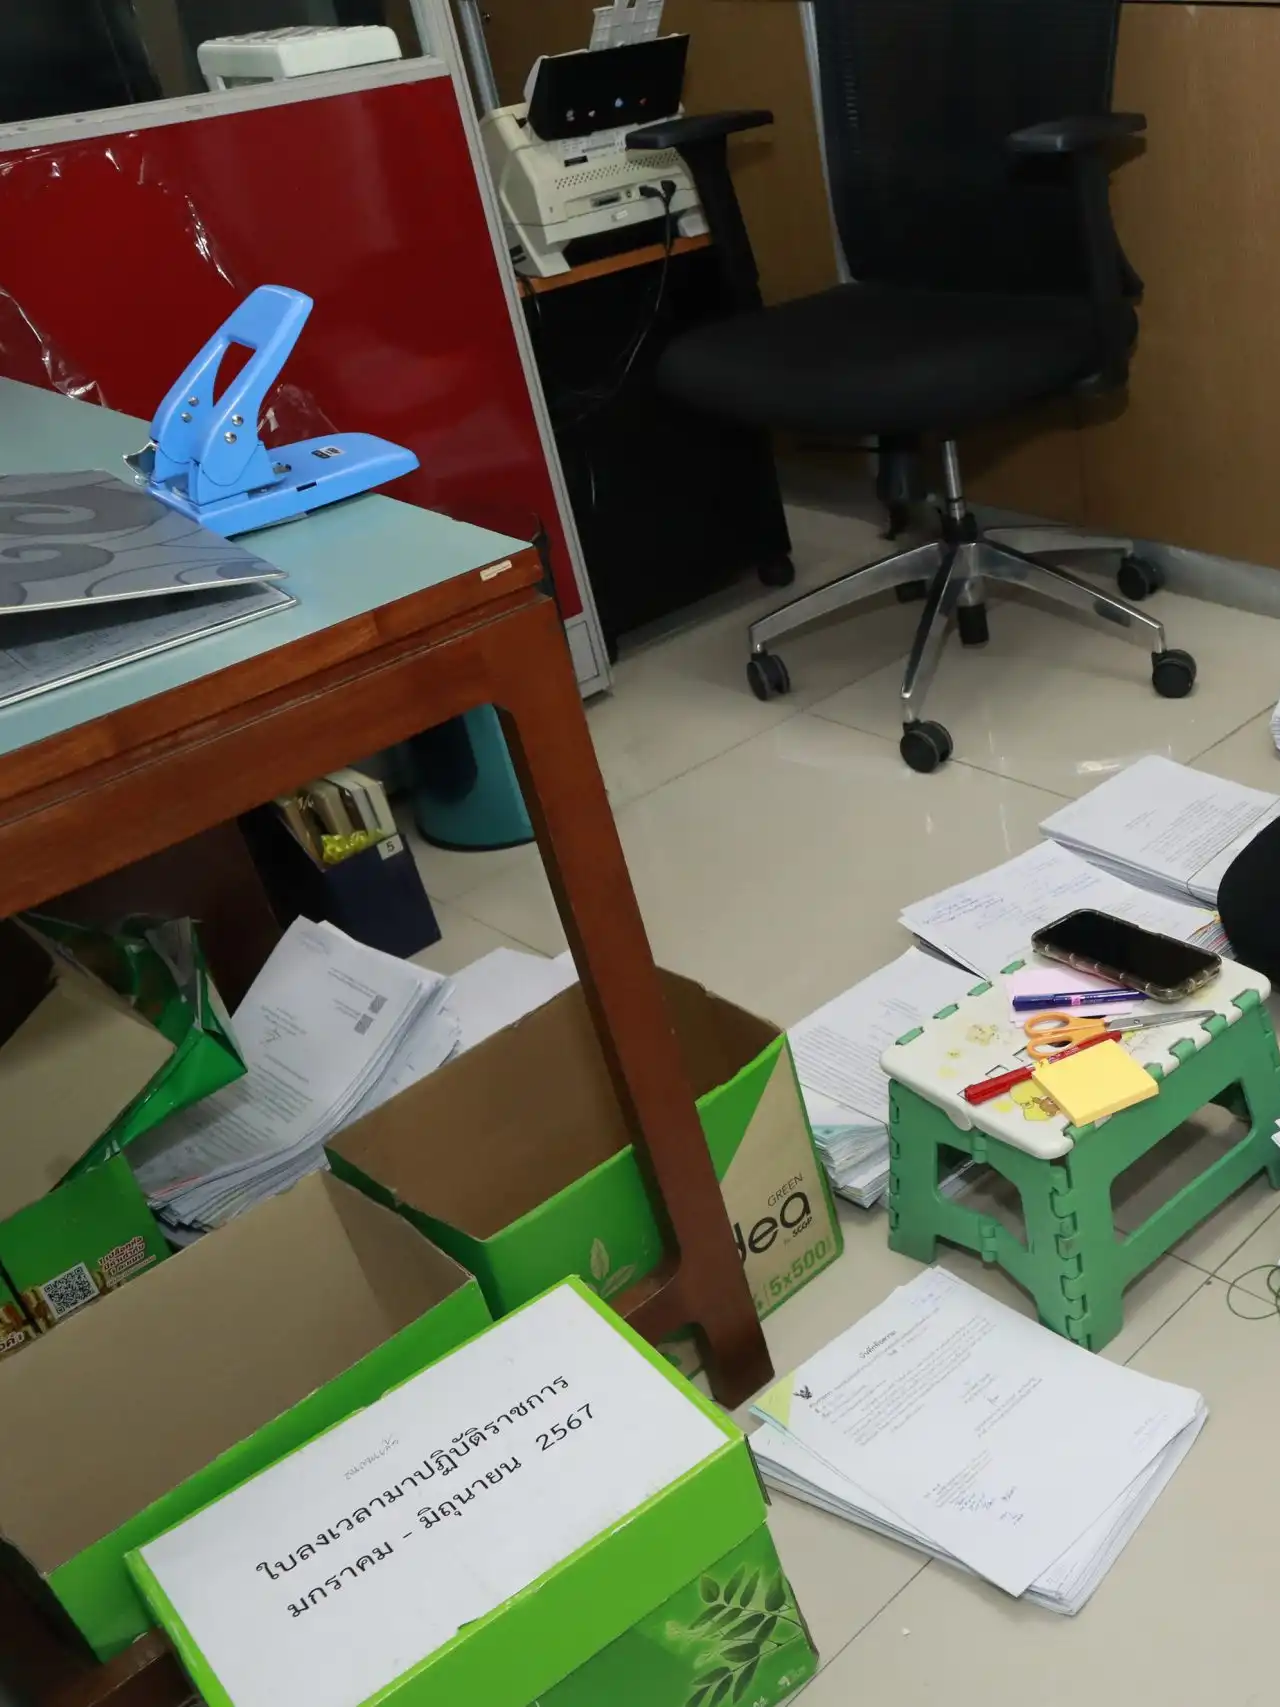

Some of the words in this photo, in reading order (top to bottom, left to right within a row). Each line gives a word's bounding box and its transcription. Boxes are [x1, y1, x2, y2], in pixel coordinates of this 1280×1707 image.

[386, 841, 396, 853] 5
[767, 1172, 804, 1207] GREEN
[769, 1240, 827, 1296] 5x500
[256, 1375, 569, 1580] ใบลงเวลามาปฏิบัติราชการ
[287, 1541, 394, 1618] มกราคม
[416, 1455, 523, 1529] มิถุนายน
[535, 1403, 596, 1451] 2567
